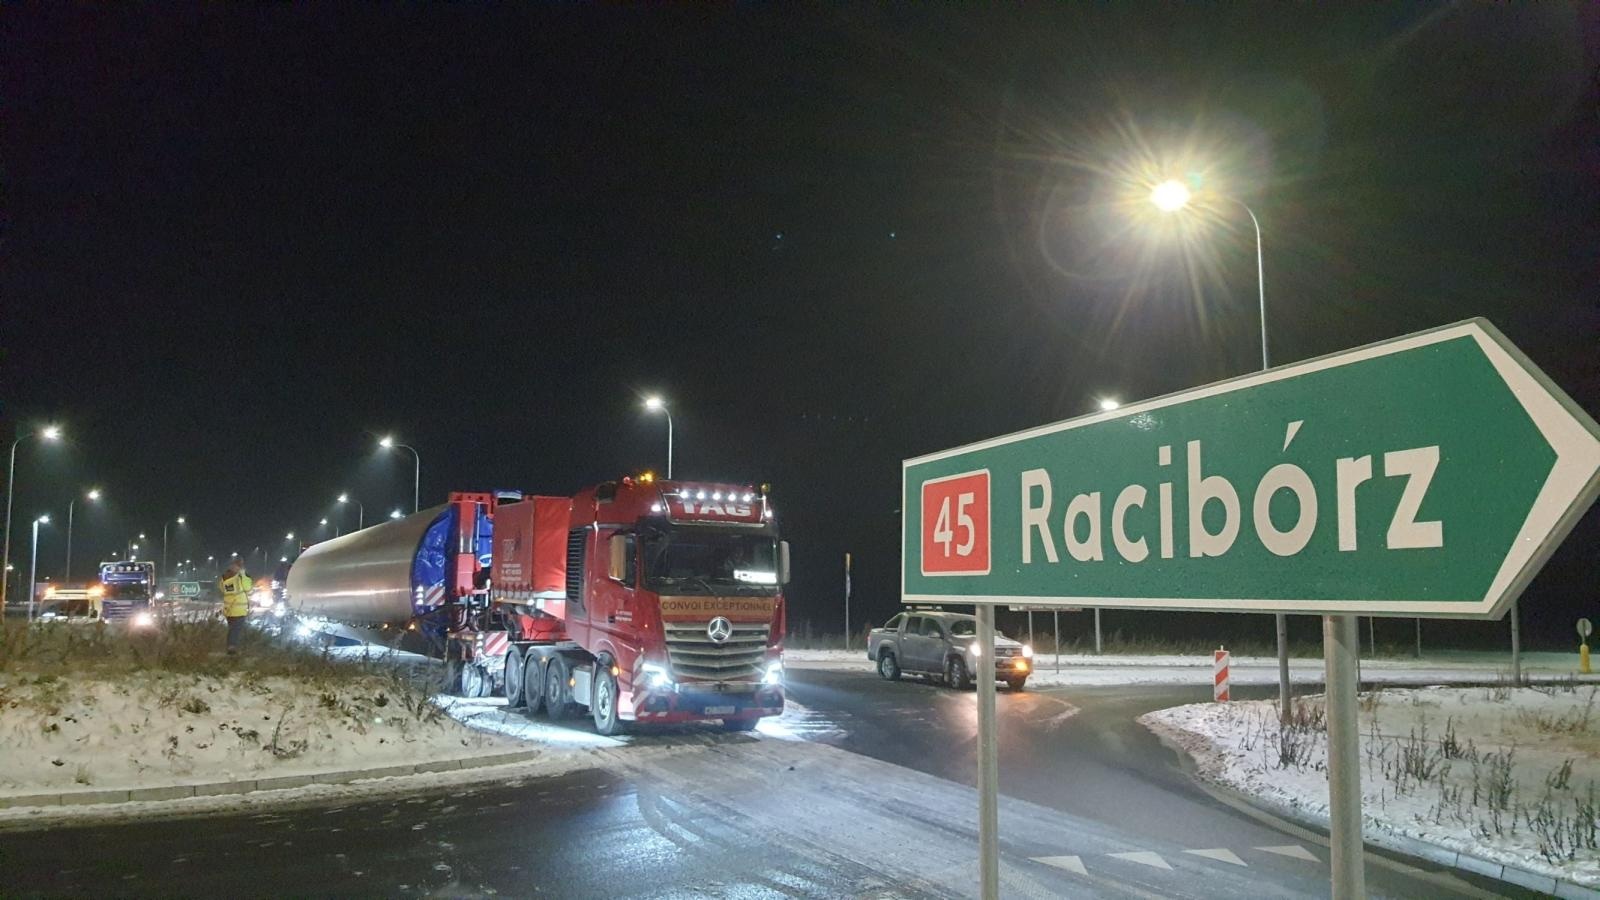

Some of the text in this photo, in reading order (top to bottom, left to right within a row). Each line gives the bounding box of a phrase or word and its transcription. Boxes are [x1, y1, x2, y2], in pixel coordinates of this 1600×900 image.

[932, 420, 1444, 564] 45 Racibórz
[661, 601, 772, 611] CONVOI EXCEPTIONNEL
